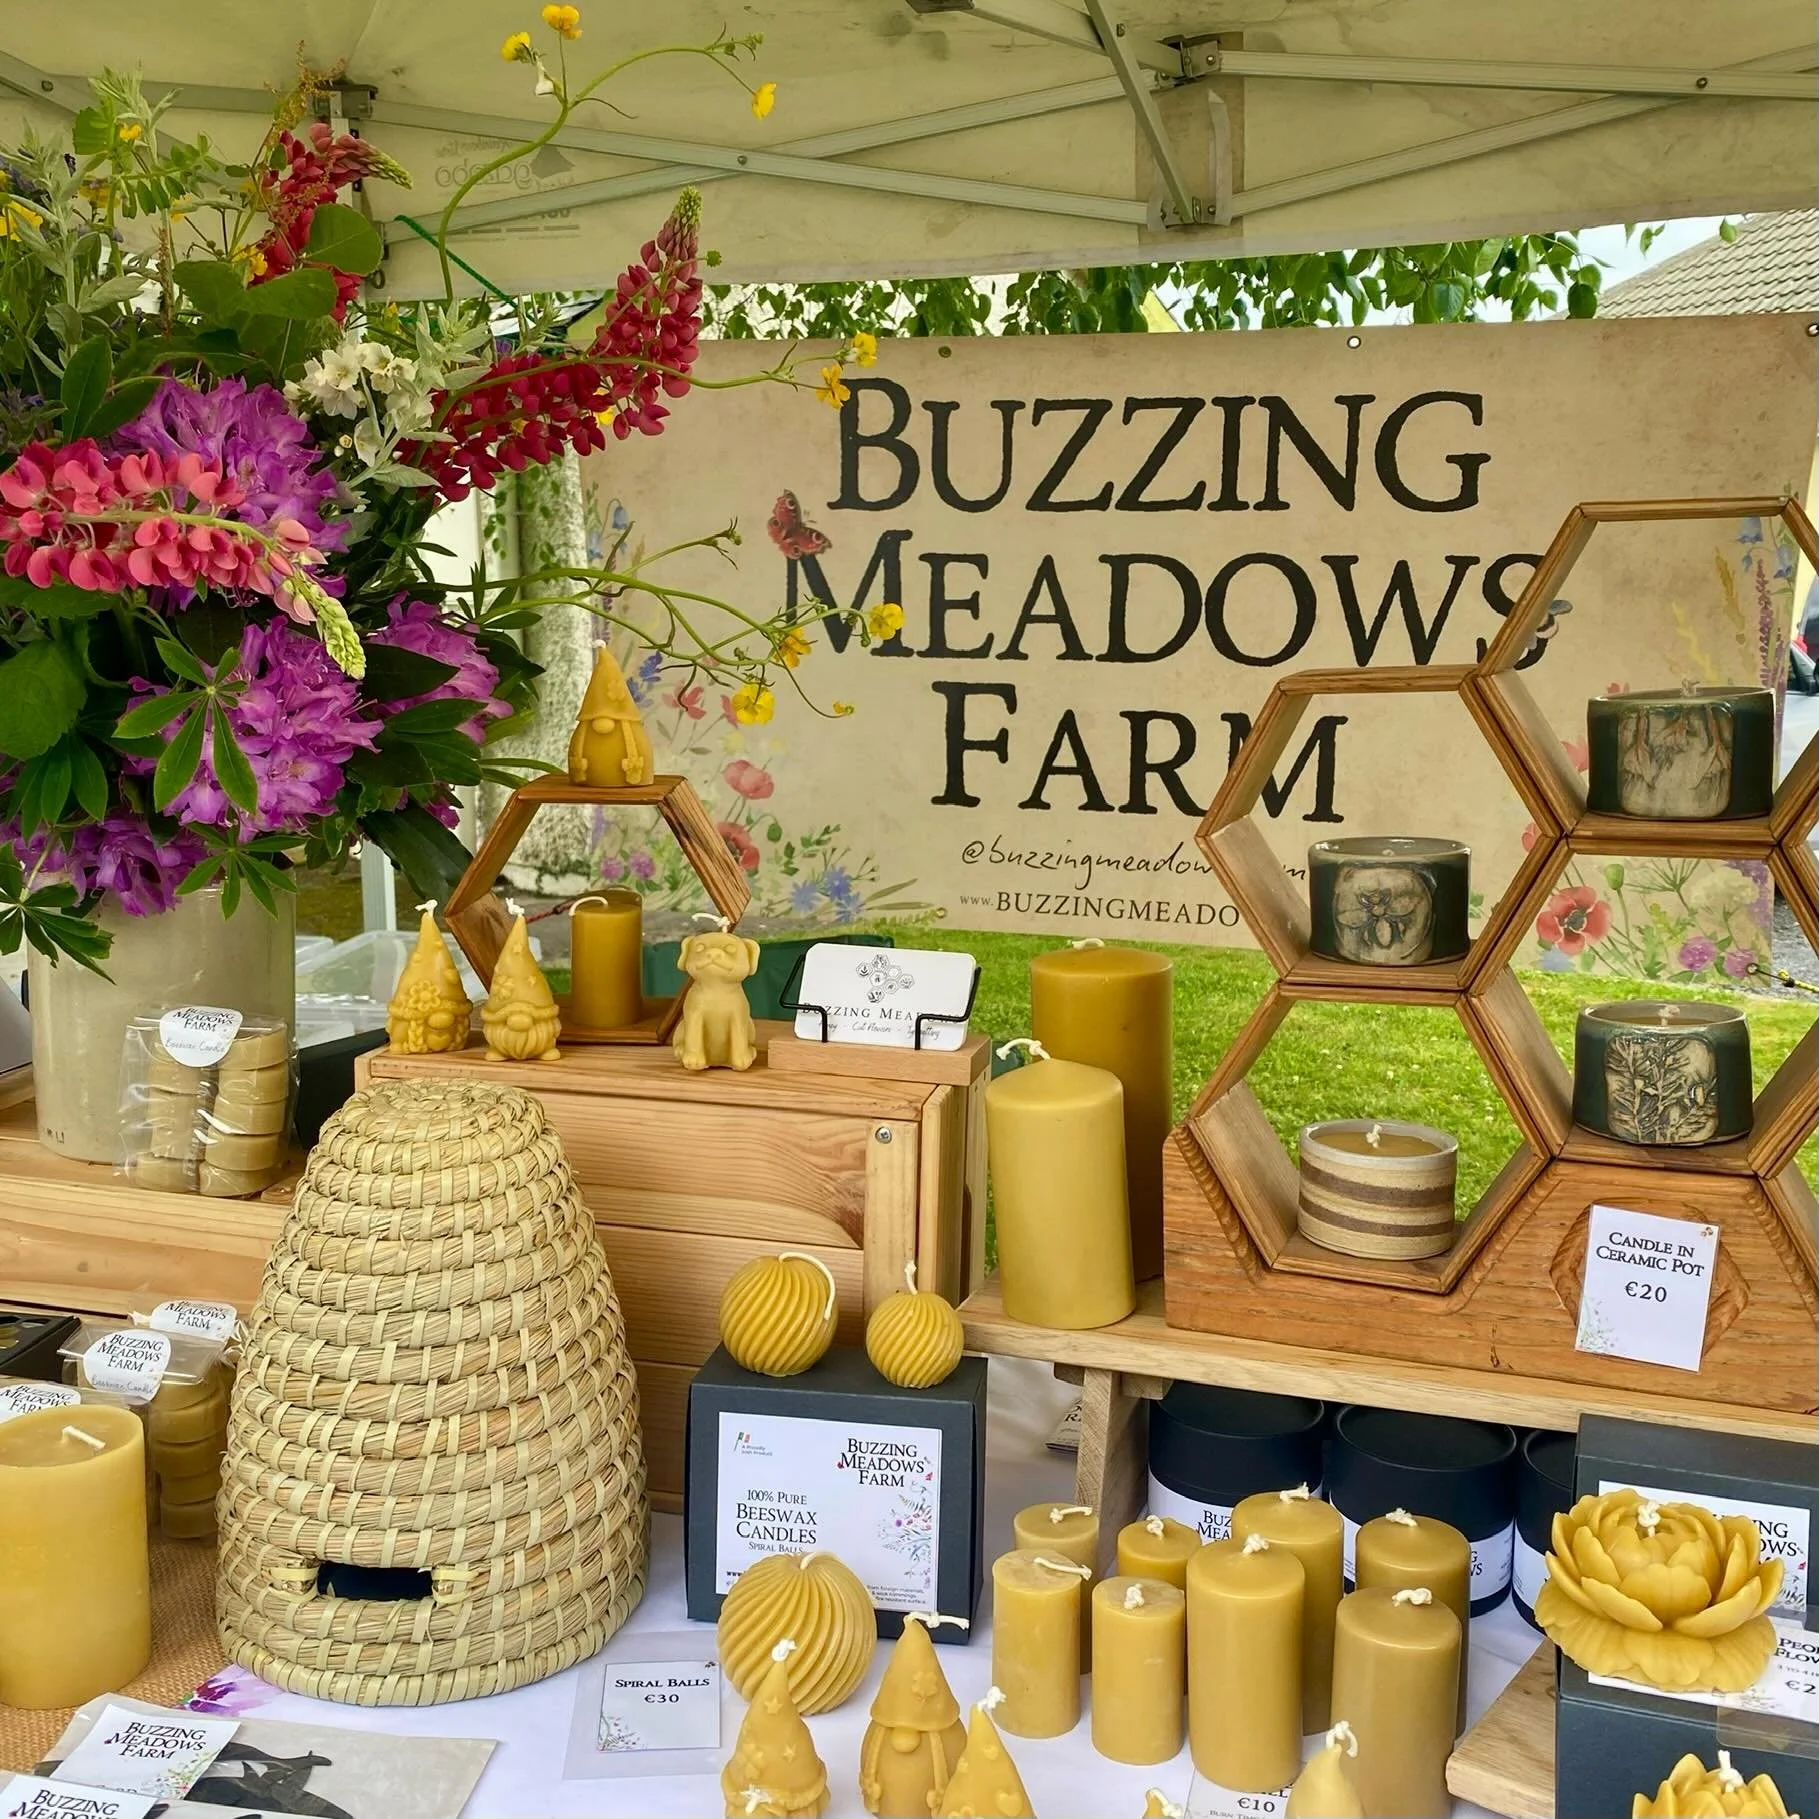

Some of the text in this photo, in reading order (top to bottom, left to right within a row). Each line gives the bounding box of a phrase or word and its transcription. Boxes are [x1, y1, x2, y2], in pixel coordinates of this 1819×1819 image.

[827, 377, 1491, 513] BUZZING
[785, 529, 1550, 671] MEADOWS
[931, 680, 1349, 824] FARM
[959, 891, 1240, 927] www.BUZZINGMEADO
[184, 1019, 217, 1032] FARM
[1609, 1232, 1696, 1258] CANDLE IN
[1596, 1245, 1705, 1277] CERAMIC POT
[1625, 1281, 1668, 1302] €20
[166, 1303, 227, 1320] MEADOWS
[175, 1313, 212, 1331] FARM
[98, 1341, 161, 1362] MEADOWS
[110, 1334, 164, 1351] BUZZING
[107, 1356, 145, 1373] FARM
[847, 1438, 918, 1457] BUZZING
[841, 1452, 925, 1474] MEADOWS
[859, 1470, 905, 1488] FARM
[747, 1489, 808, 1505] 100% PURE
[736, 1503, 818, 1526] BEESWAX
[736, 1521, 817, 1544] CANDLES
[748, 1541, 804, 1553] SPIRAL BALLS
[1779, 1637, 1819, 1655] PEO
[615, 1678, 710, 1688] SPIRAL BALLS
[644, 1694, 679, 1704] €30
[124, 1721, 207, 1741] BUZZING
[108, 1732, 207, 1752] MEADOWS
[118, 1745, 176, 1760] FARM
[31, 1789, 120, 1816] BUZZING
[1238, 1797, 1276, 1813] €10
